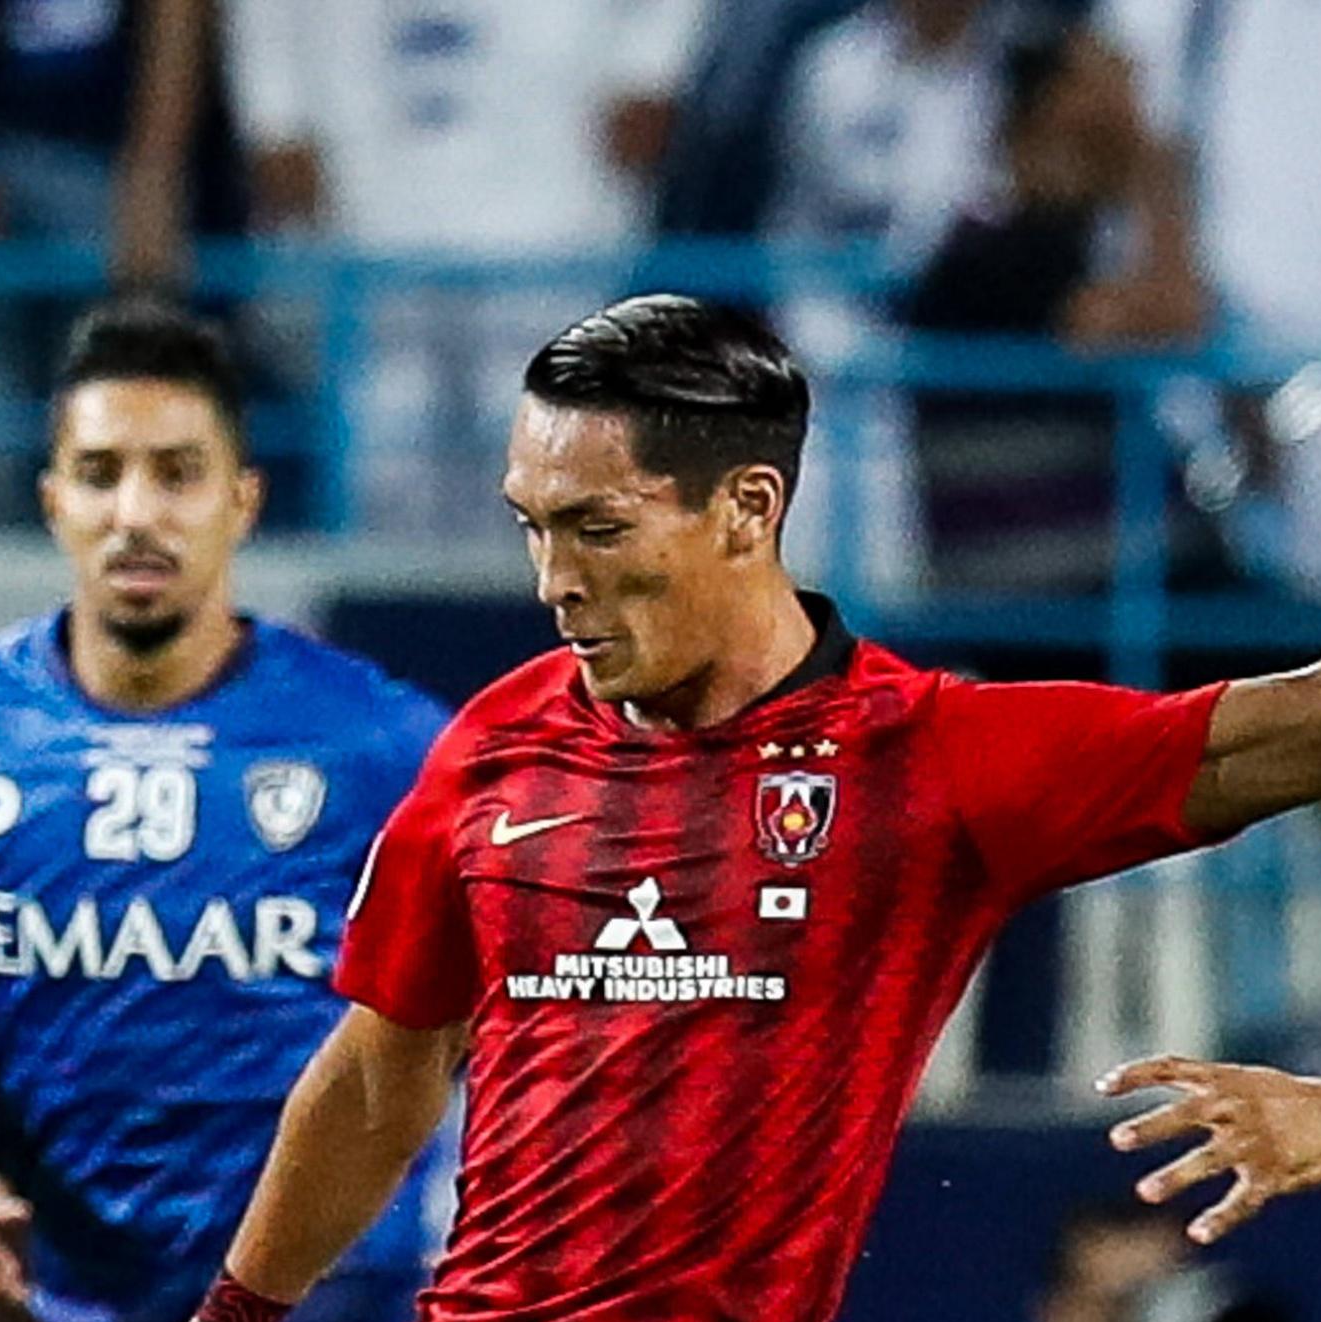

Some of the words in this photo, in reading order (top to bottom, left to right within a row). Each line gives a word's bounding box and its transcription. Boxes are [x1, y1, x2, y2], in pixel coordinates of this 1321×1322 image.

[84, 767, 198, 863] 29
[553, 953, 729, 979] MITSUBISHI
[506, 974, 596, 1000] HEAVY
[603, 976, 786, 1002] INDUSTRIES
